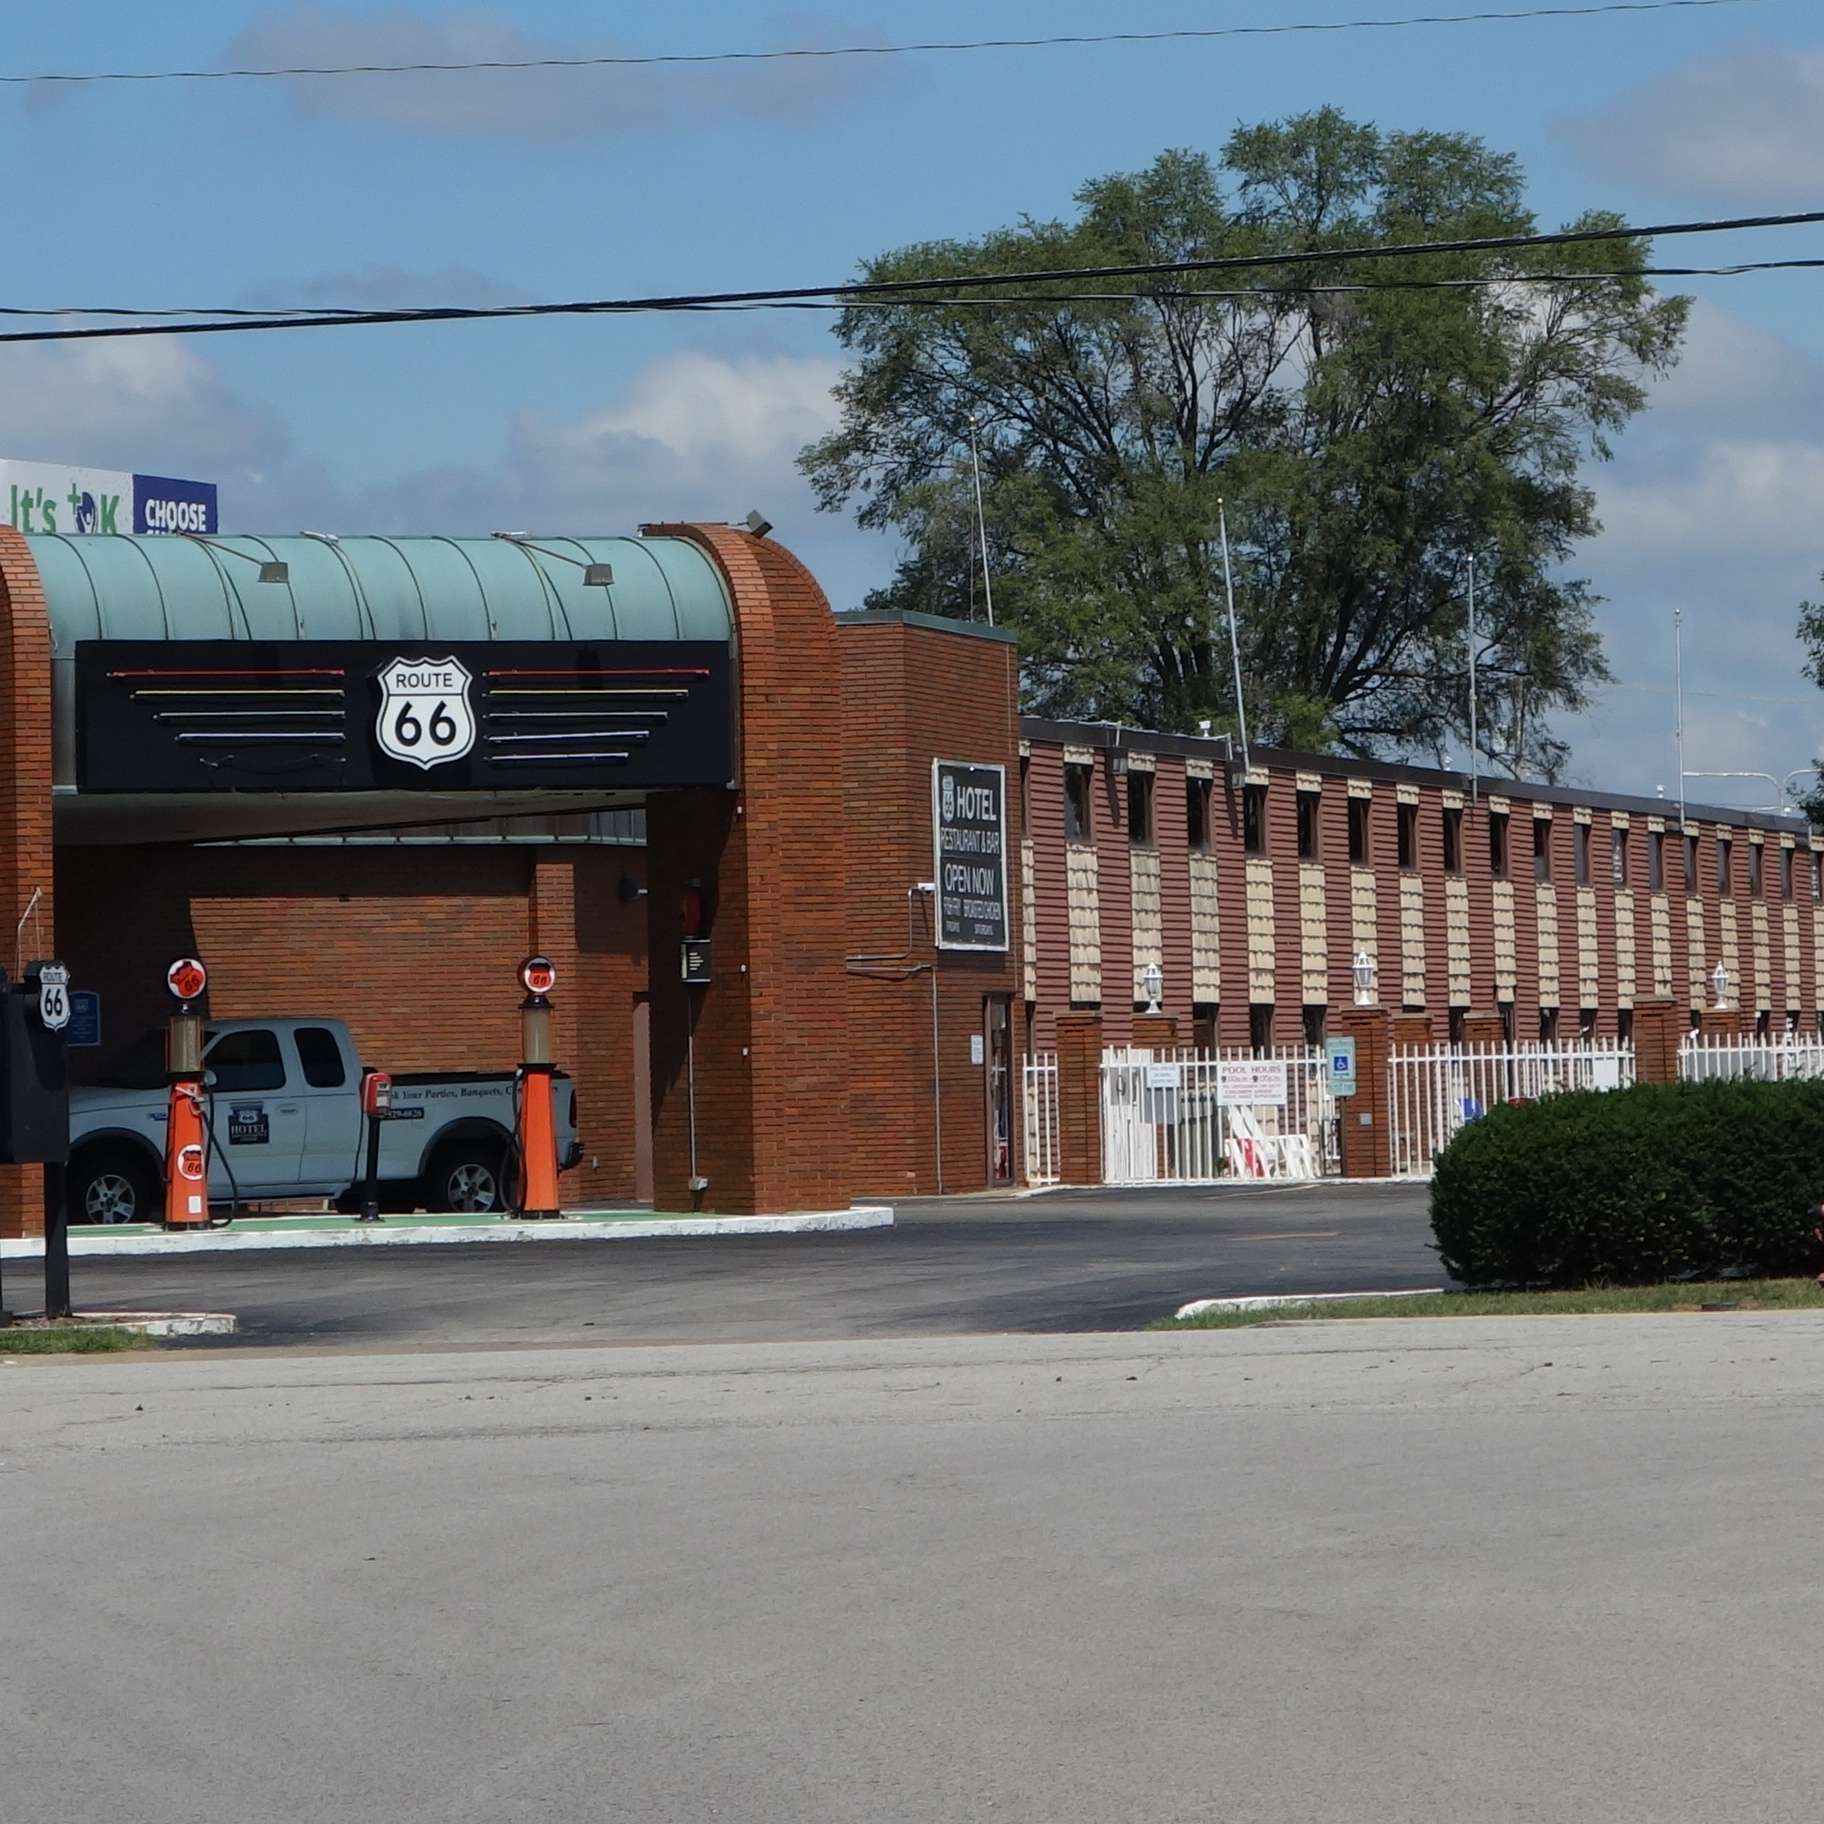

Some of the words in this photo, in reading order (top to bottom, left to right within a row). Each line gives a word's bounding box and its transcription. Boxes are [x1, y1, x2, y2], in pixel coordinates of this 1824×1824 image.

[10, 484, 57, 533] It's
[144, 498, 207, 532] CHOOSE
[395, 672, 454, 689] ROUTE
[394, 700, 457, 748] 66
[956, 785, 998, 821] HOTEL
[944, 862, 972, 893] OPEN
[972, 866, 995, 896] NOW
[44, 988, 63, 1017] 66
